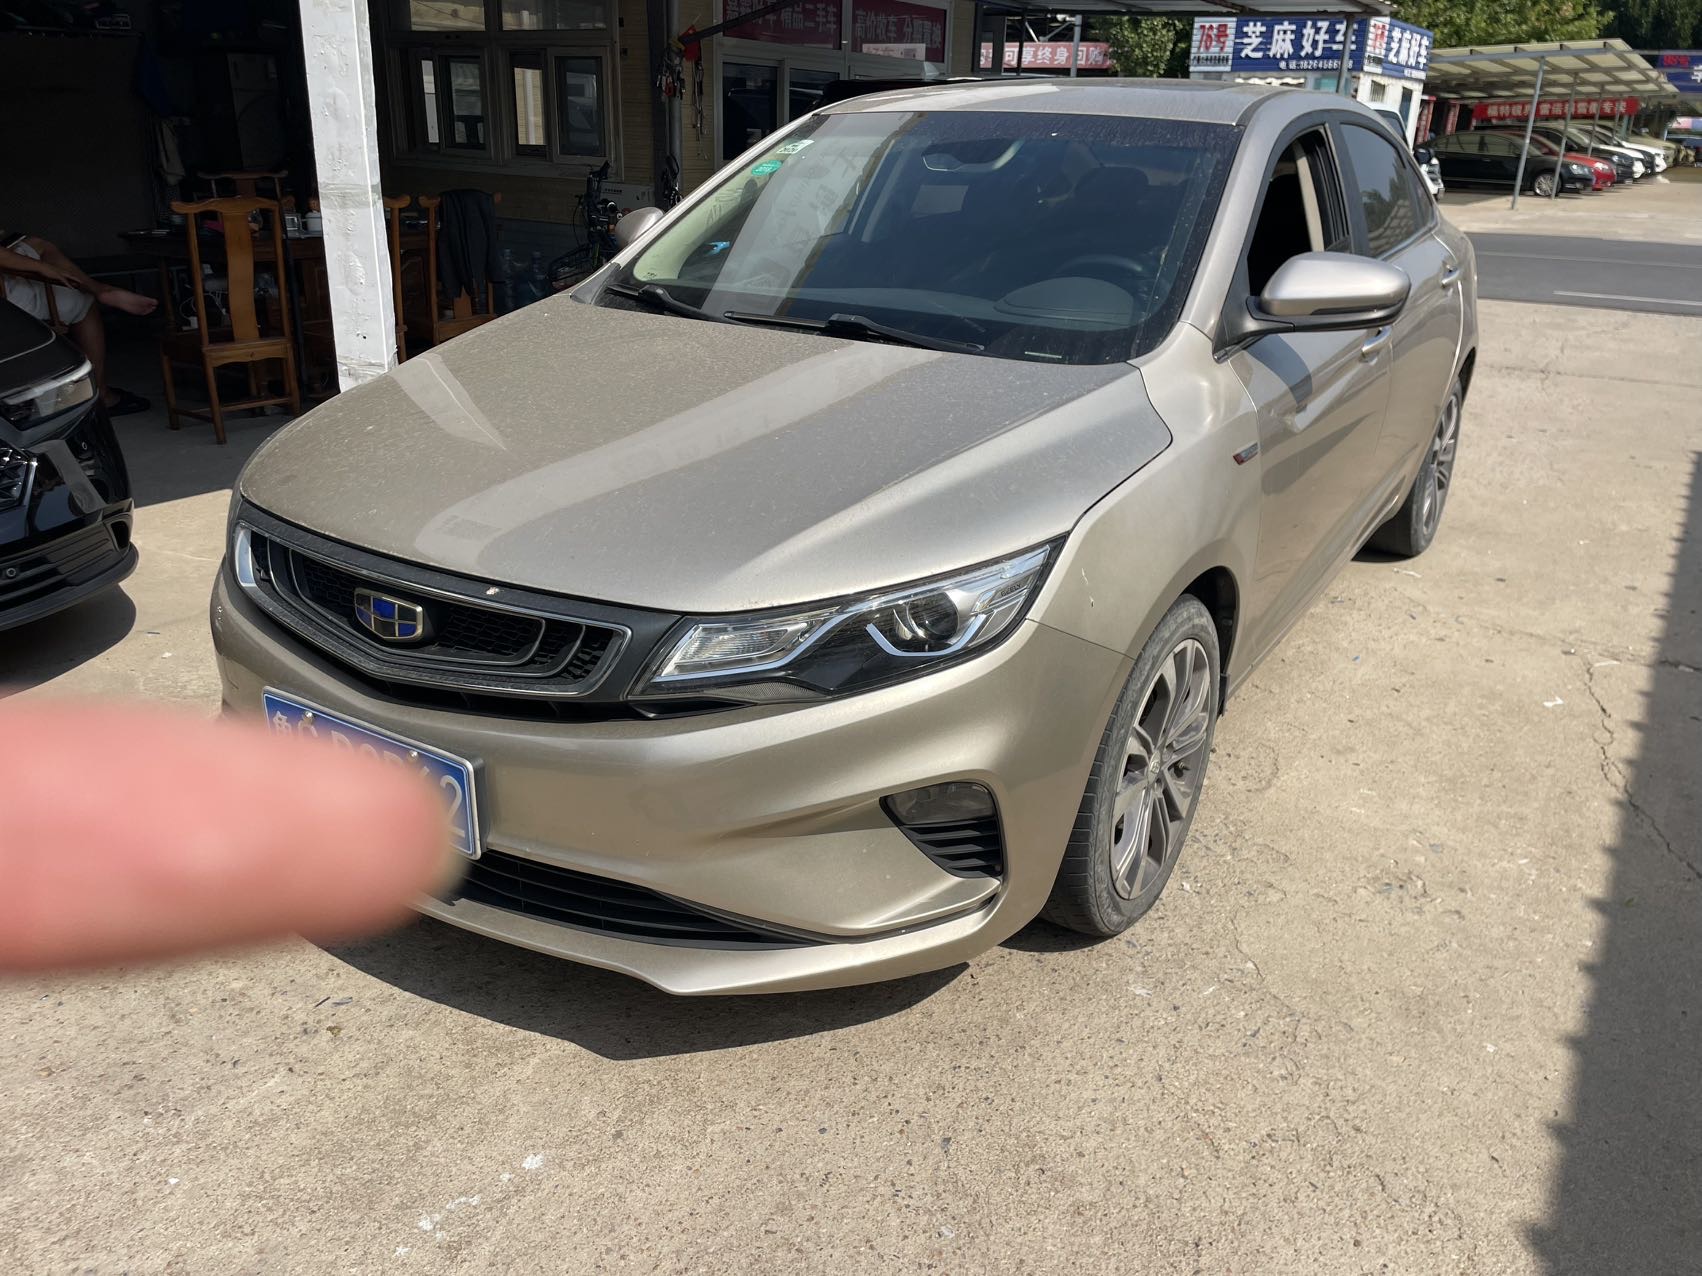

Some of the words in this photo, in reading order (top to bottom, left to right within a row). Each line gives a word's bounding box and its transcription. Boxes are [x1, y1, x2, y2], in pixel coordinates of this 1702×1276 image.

[1239, 20, 1357, 58] 芝麻好车
[1387, 26, 1430, 69] 芝麻好车
